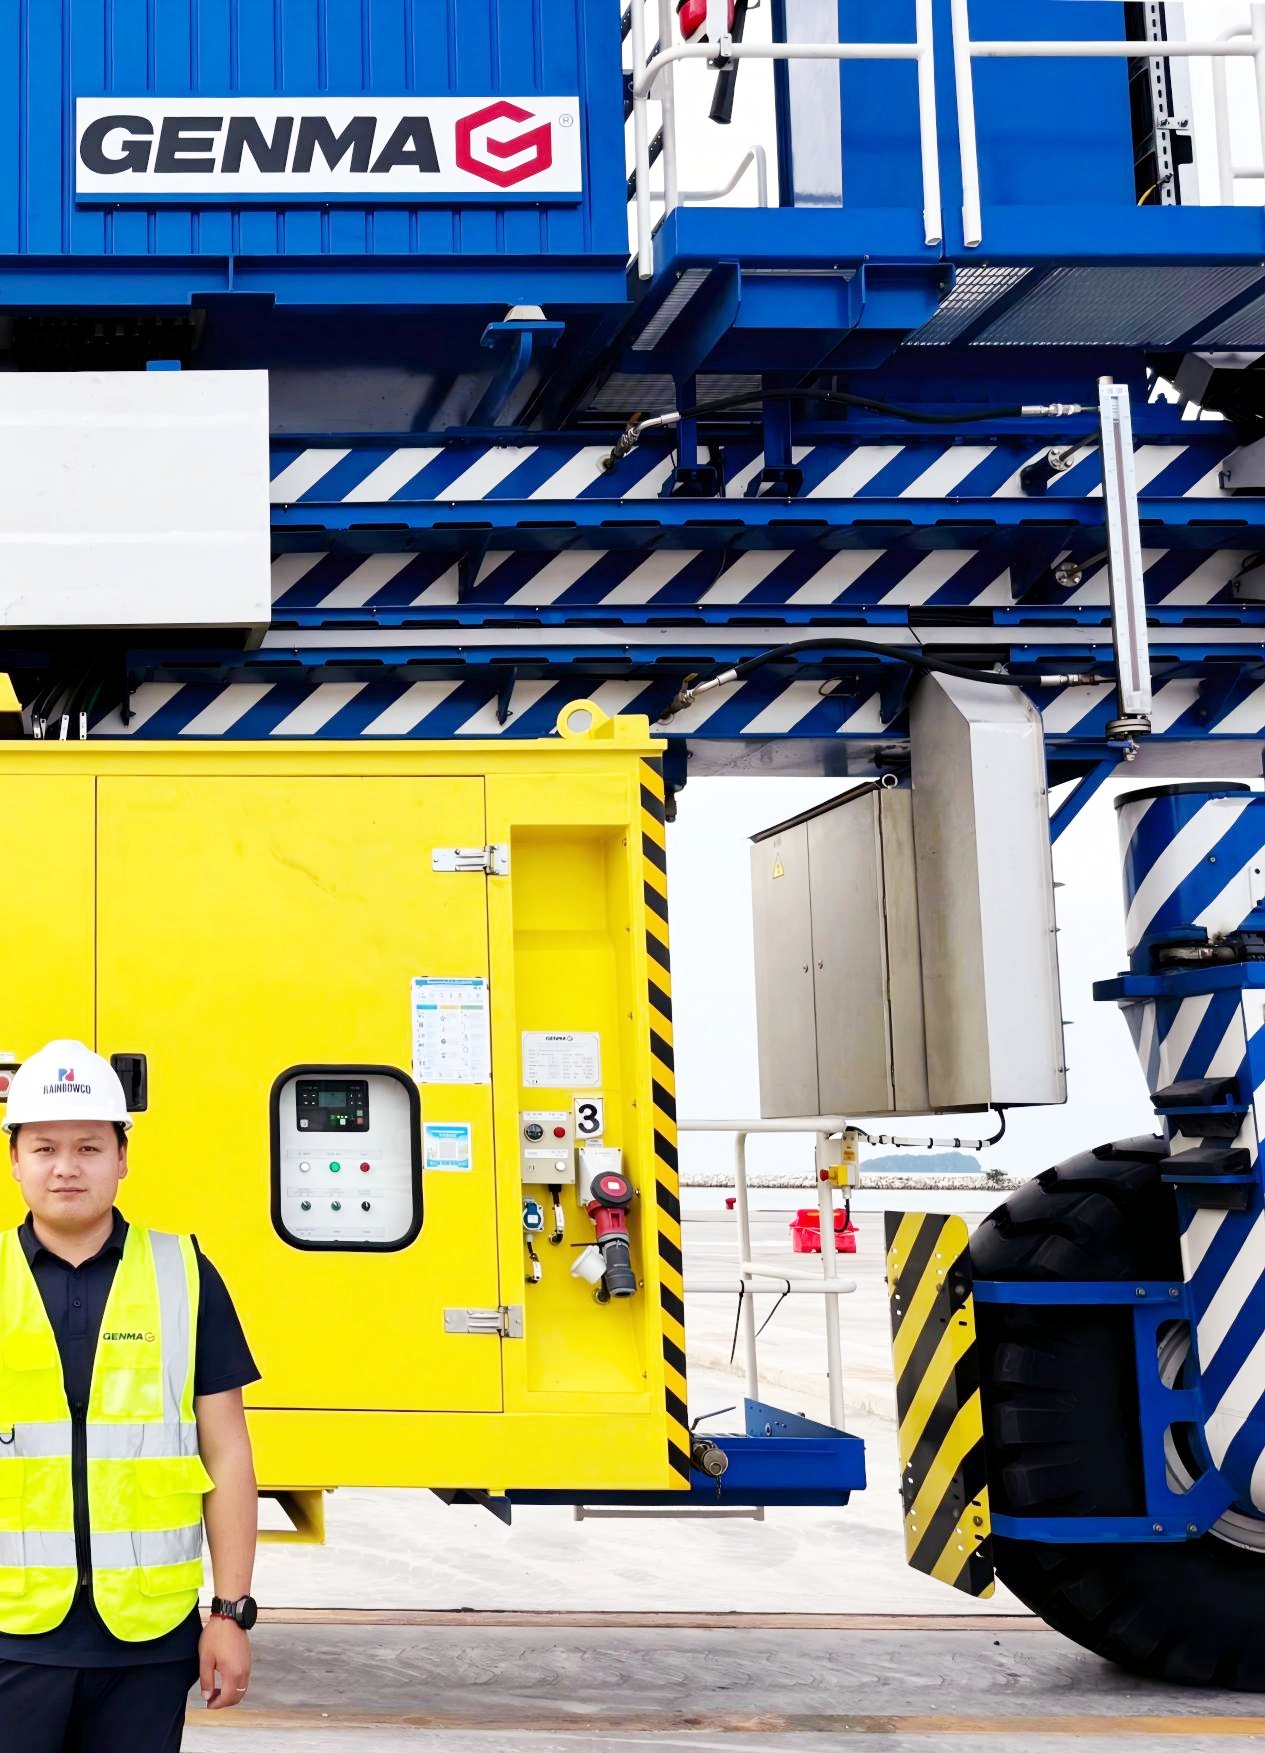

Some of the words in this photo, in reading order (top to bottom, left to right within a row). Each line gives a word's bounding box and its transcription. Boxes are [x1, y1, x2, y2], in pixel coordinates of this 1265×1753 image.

[79, 115, 441, 175] GENMA
[43, 1082, 92, 1095] RAINBOWCO
[578, 1103, 600, 1134] 3
[102, 1332, 144, 1341] GENMA
